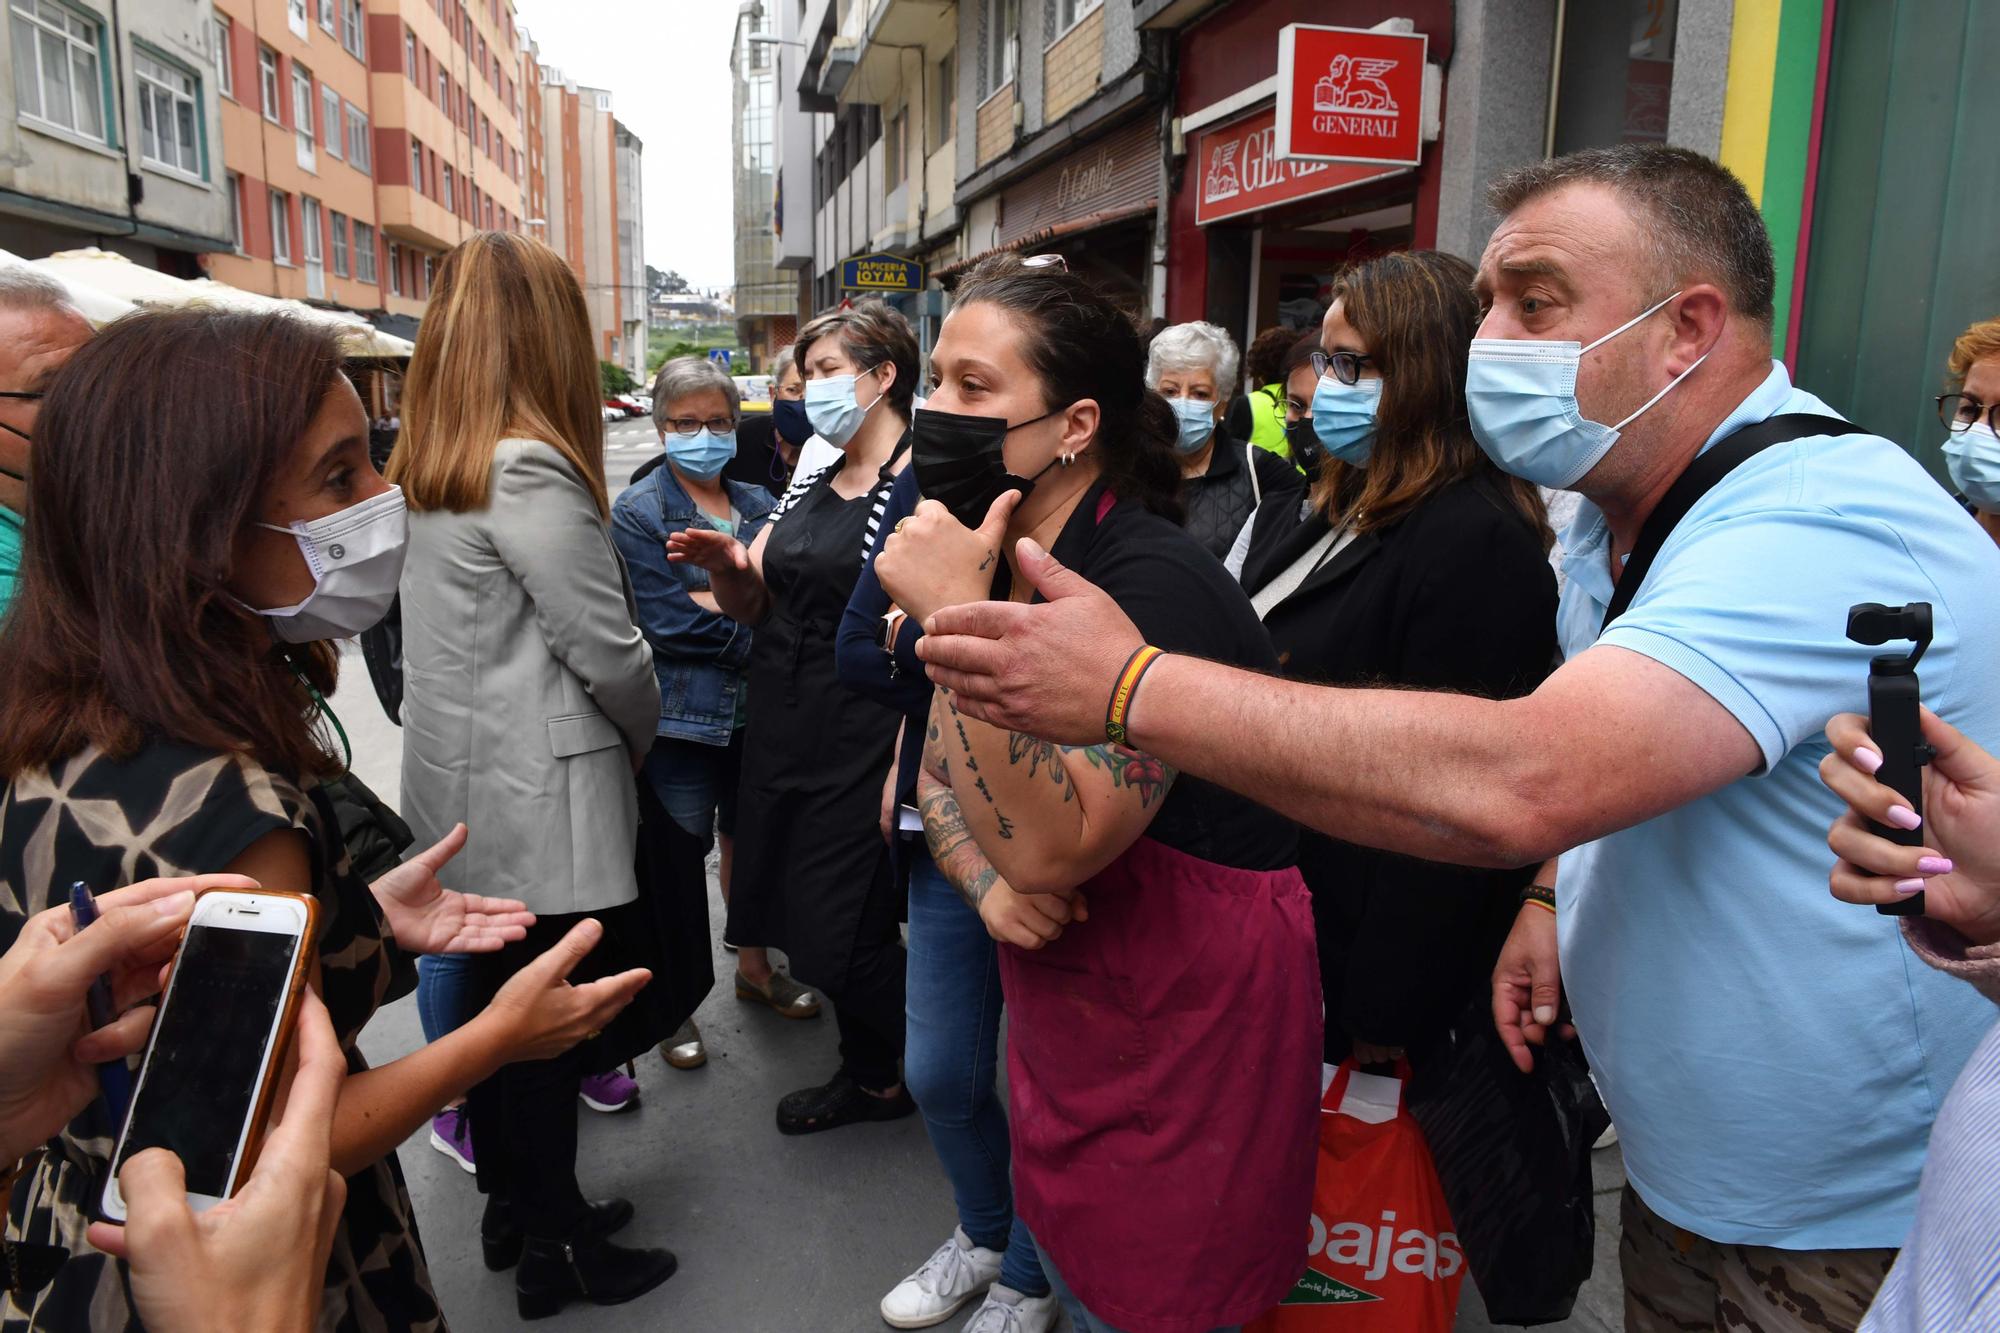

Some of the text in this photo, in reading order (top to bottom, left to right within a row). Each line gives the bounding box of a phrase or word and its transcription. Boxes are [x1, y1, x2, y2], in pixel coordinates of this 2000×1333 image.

[1312, 114, 1398, 138] GENERALI
[857, 270, 908, 286] LOYMA
[1114, 685, 1129, 718] CIVIL
